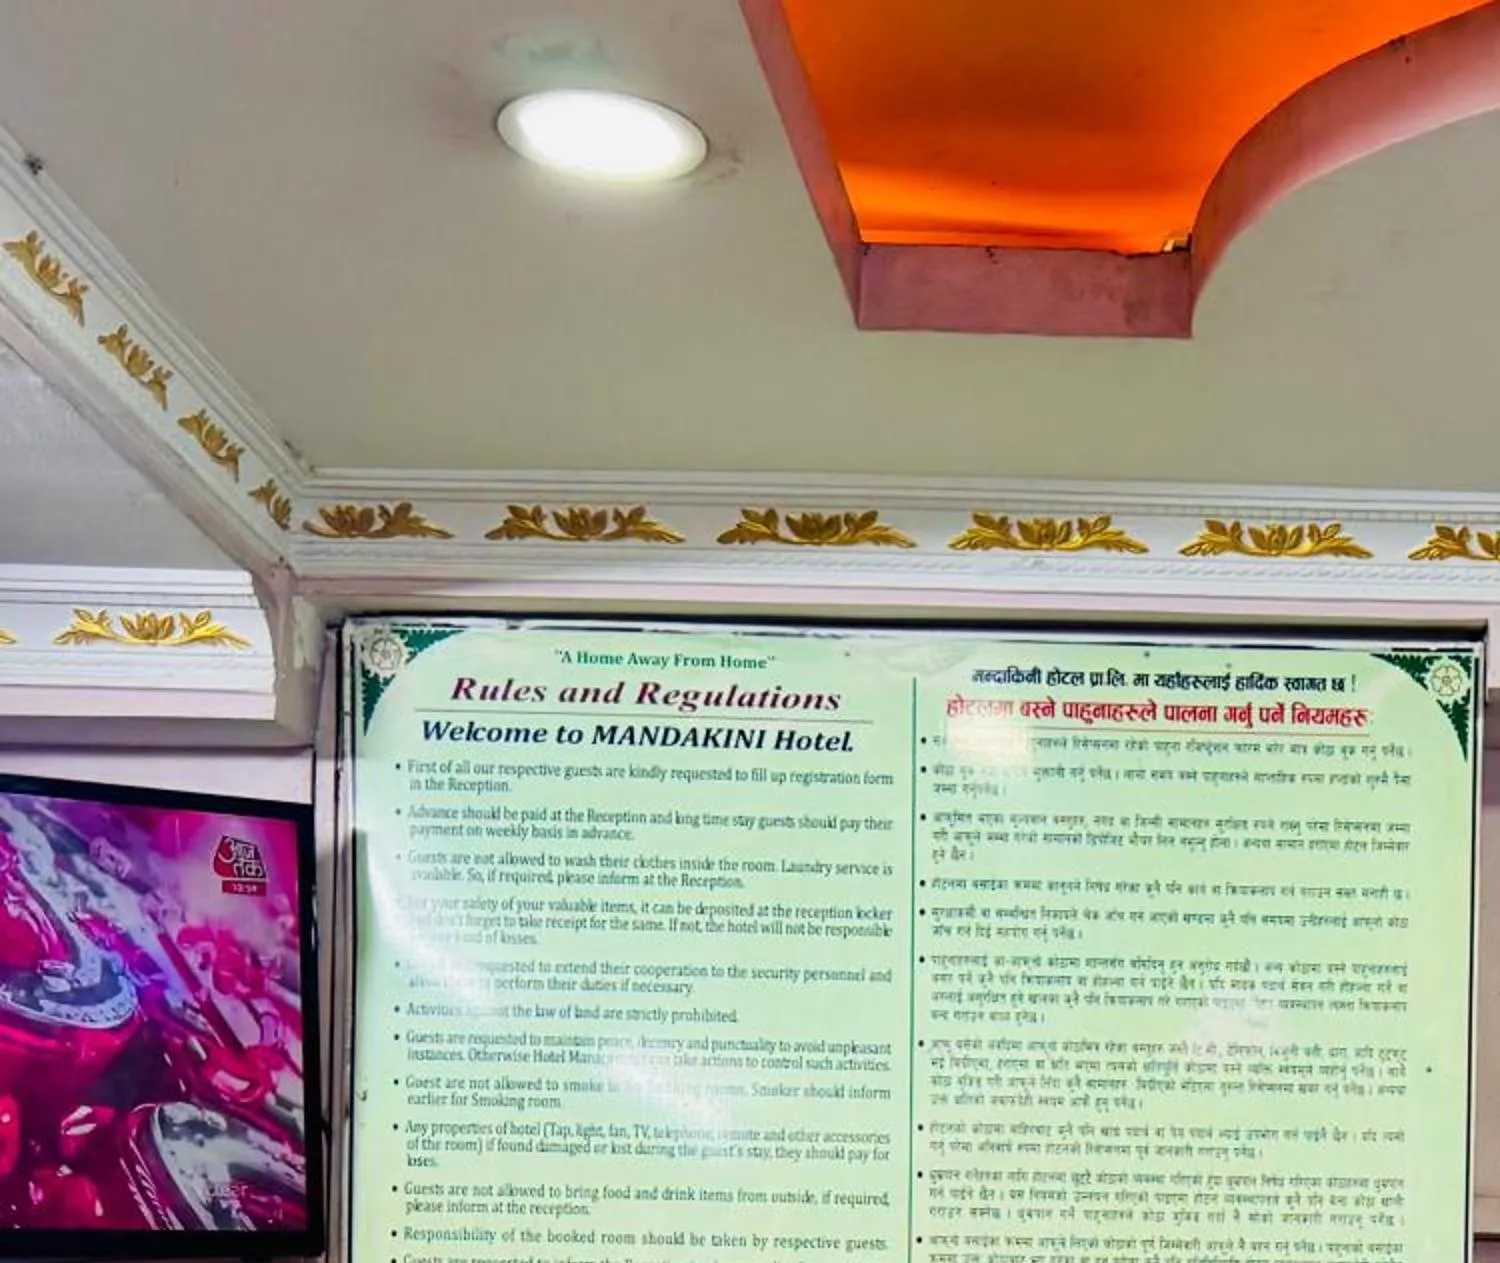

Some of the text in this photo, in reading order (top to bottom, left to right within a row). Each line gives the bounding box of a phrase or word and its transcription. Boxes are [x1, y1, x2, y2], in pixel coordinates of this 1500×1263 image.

[577, 652, 623, 666] Home
[627, 652, 668, 669] Away
[674, 654, 716, 668] From
[1045, 667, 1084, 687] होटल
[1133, 673, 1149, 688] मा
[1284, 676, 1327, 692] स्वागत
[1331, 677, 1345, 692] छ
[451, 677, 841, 712] Rules and Regulations
[1164, 704, 1217, 724] पालना
[422, 720, 853, 752] Welcome to MANDAKINI Hotel.
[440, 760, 452, 774] of
[455, 760, 470, 775] all
[474, 765, 493, 776] our
[498, 763, 560, 779] respective
[564, 765, 603, 780] guests
[605, 767, 625, 778] are
[629, 765, 667, 782] kindly
[671, 768, 732, 784] requested
[735, 770, 748, 782] to
[750, 769, 767, 782] fill
[770, 773, 786, 786] up
[790, 771, 861, 787] registration
[863, 770, 894, 785] form
[404, 1227, 497, 1245] Responsibility
[502, 1228, 515, 1241] of
[520, 1229, 542, 1243] the
[547, 1230, 595, 1244] booked
[601, 1234, 635, 1244] room
[642, 1231, 684, 1245] should
[690, 1232, 706, 1246] be
[711, 1233, 747, 1247] taken
[752, 1234, 768, 1250] by
[773, 1236, 841, 1251] respective
